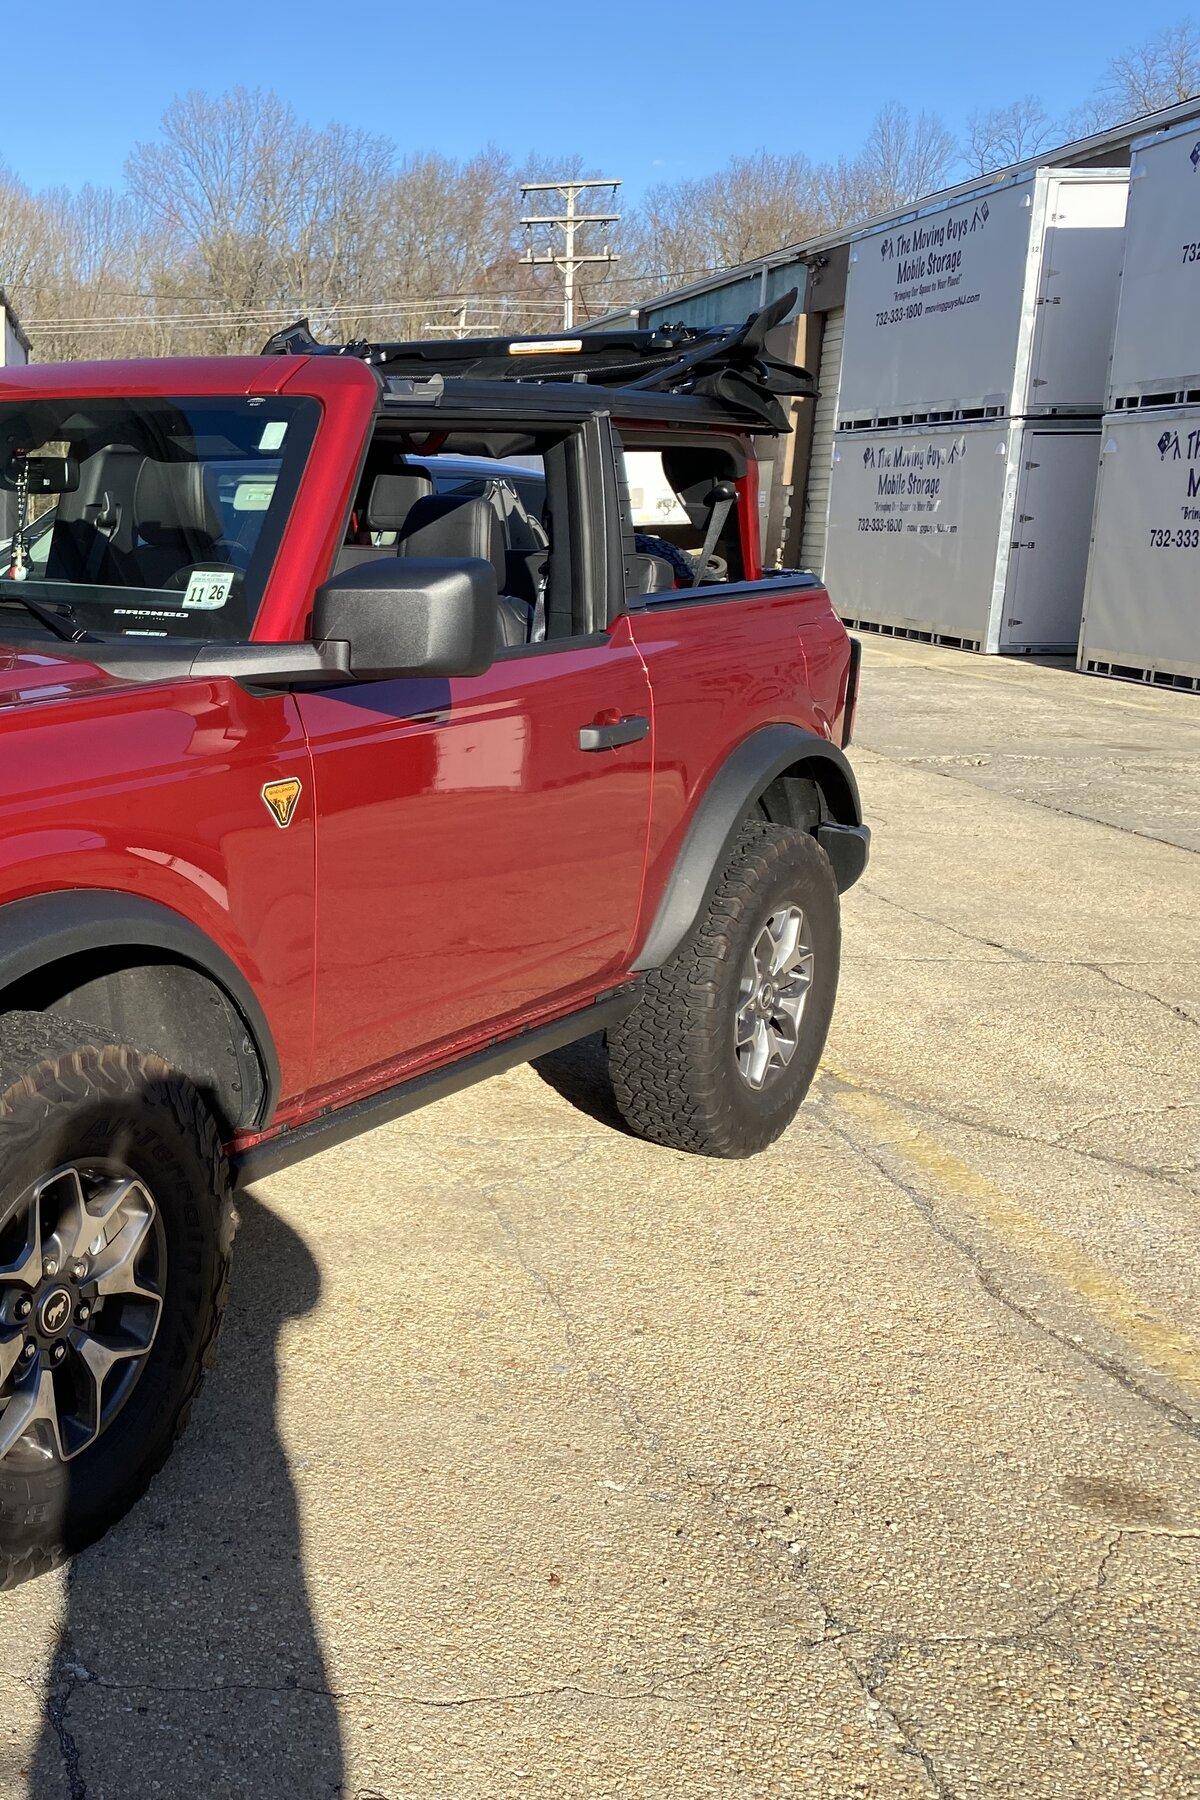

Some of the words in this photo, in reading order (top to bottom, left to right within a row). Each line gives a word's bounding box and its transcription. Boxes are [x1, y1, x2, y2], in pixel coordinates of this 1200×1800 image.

[897, 234, 911, 257] The
[912, 225, 945, 252] Moving
[947, 218, 968, 241] Guys
[897, 256, 925, 284] Mobile
[927, 250, 961, 275] Storage
[875, 302, 923, 327] 732-333-1800
[878, 473, 905, 495] Mobile
[907, 472, 940, 499] Storage
[857, 518, 903, 532] 732-333-1800
[188, 587, 205, 602] 11
[208, 585, 225, 600] 26
[113, 608, 189, 618] BRONCO
